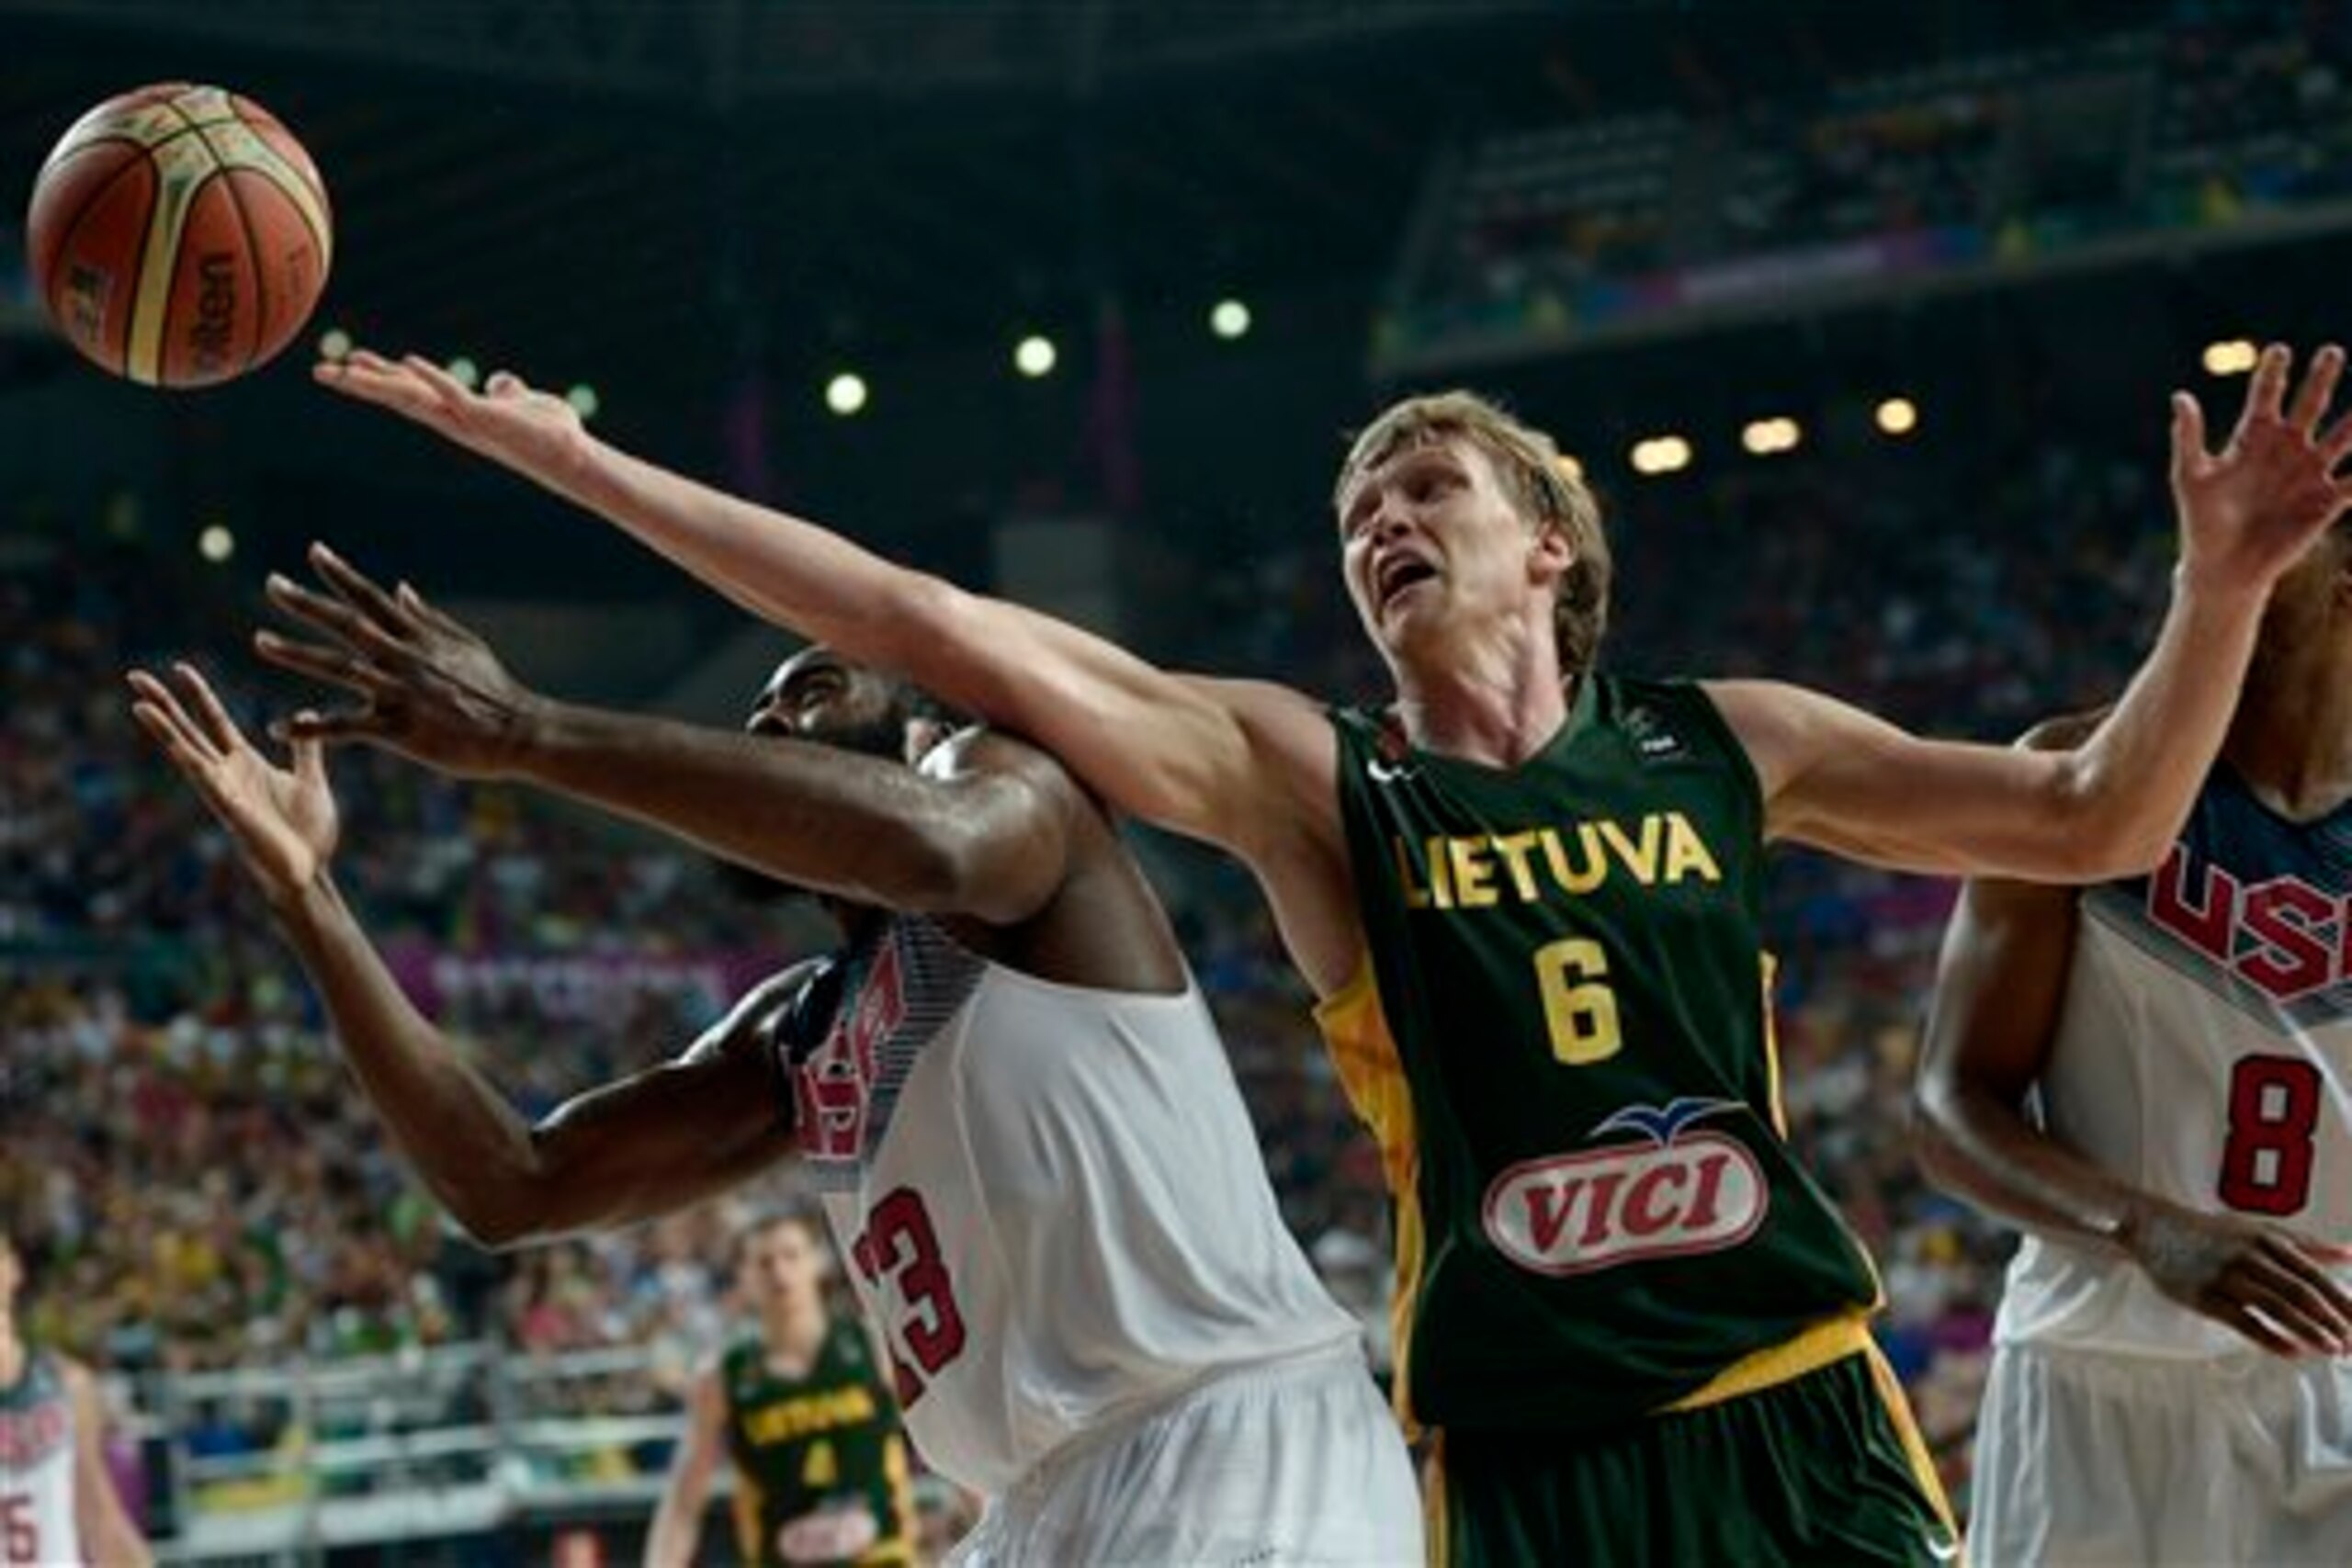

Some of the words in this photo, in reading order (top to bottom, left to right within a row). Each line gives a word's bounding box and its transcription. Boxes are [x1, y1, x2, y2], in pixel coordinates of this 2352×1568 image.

[1393, 810, 1723, 909] LIETUVA
[2147, 840, 2352, 1005] US
[1532, 936, 1623, 1066] 6
[2218, 1053, 2324, 1219] 8
[1523, 1154, 1731, 1250] VICI
